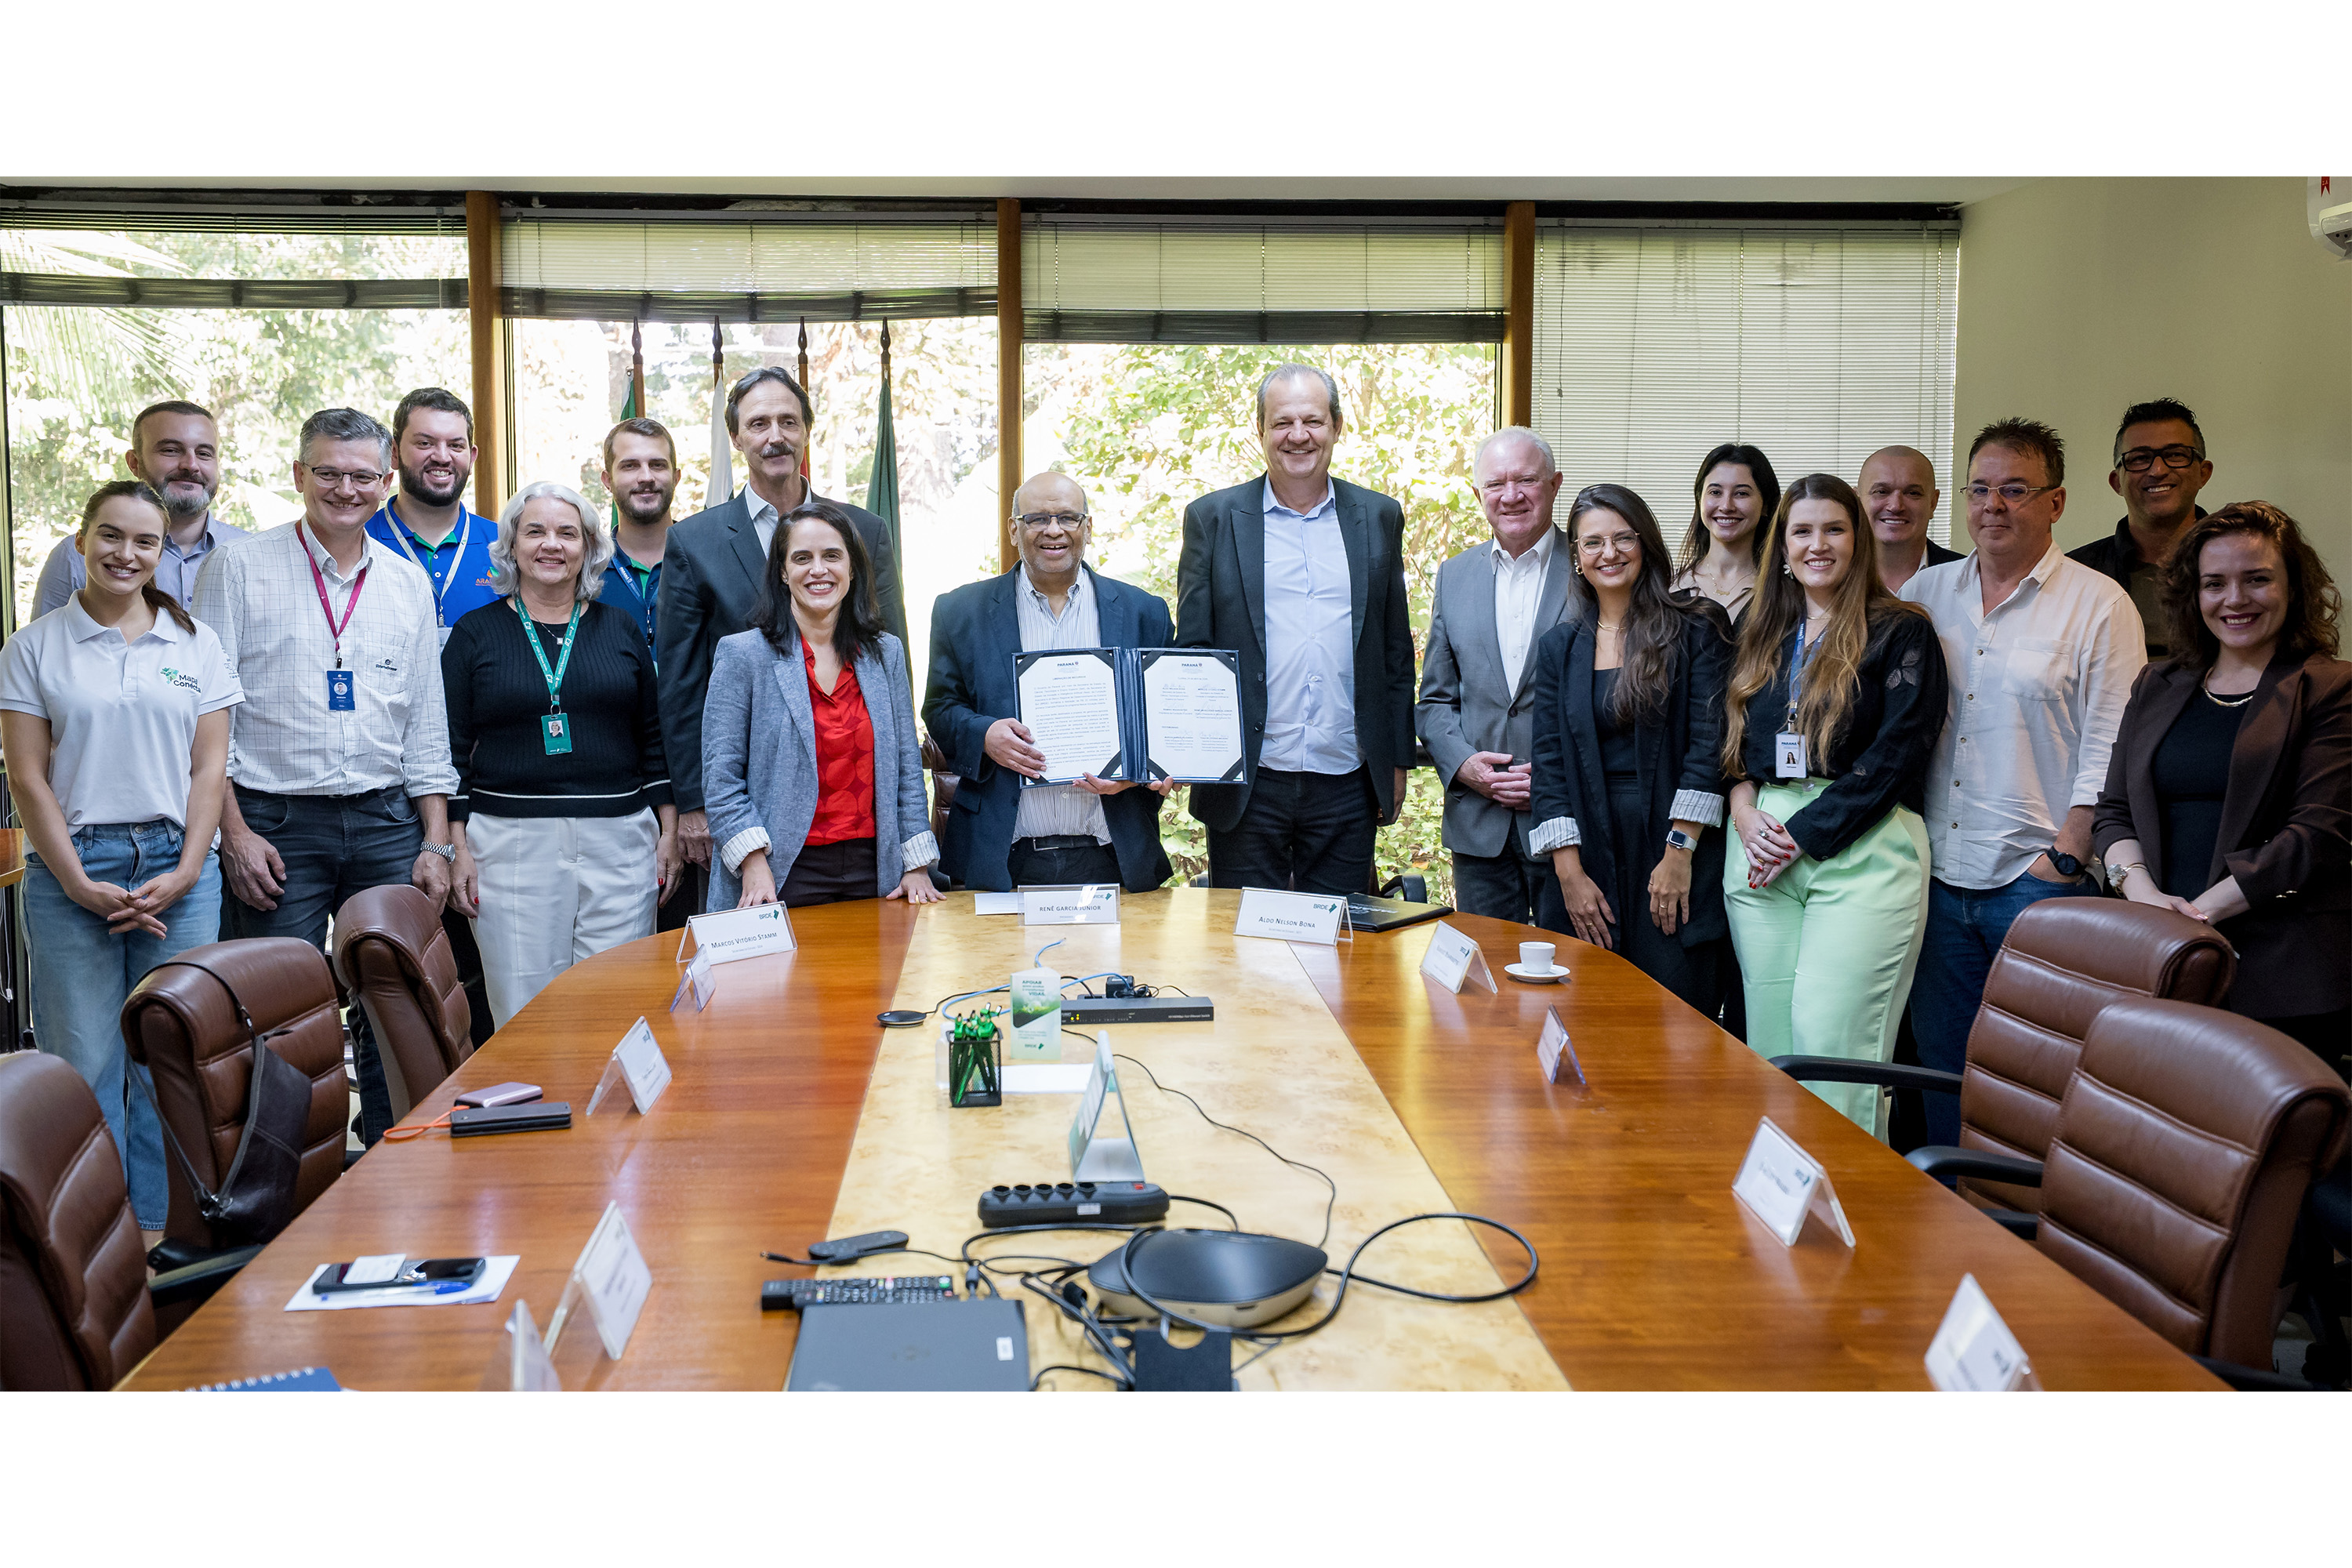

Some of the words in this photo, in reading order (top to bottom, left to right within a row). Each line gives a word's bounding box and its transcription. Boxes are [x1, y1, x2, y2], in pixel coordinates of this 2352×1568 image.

[179, 674, 198, 685] Mapa
[173, 680, 201, 693] Conecta
[711, 940, 735, 949] MARCOS
[735, 935, 757, 945] VITÓRIO
[757, 932, 778, 941] STAMM
